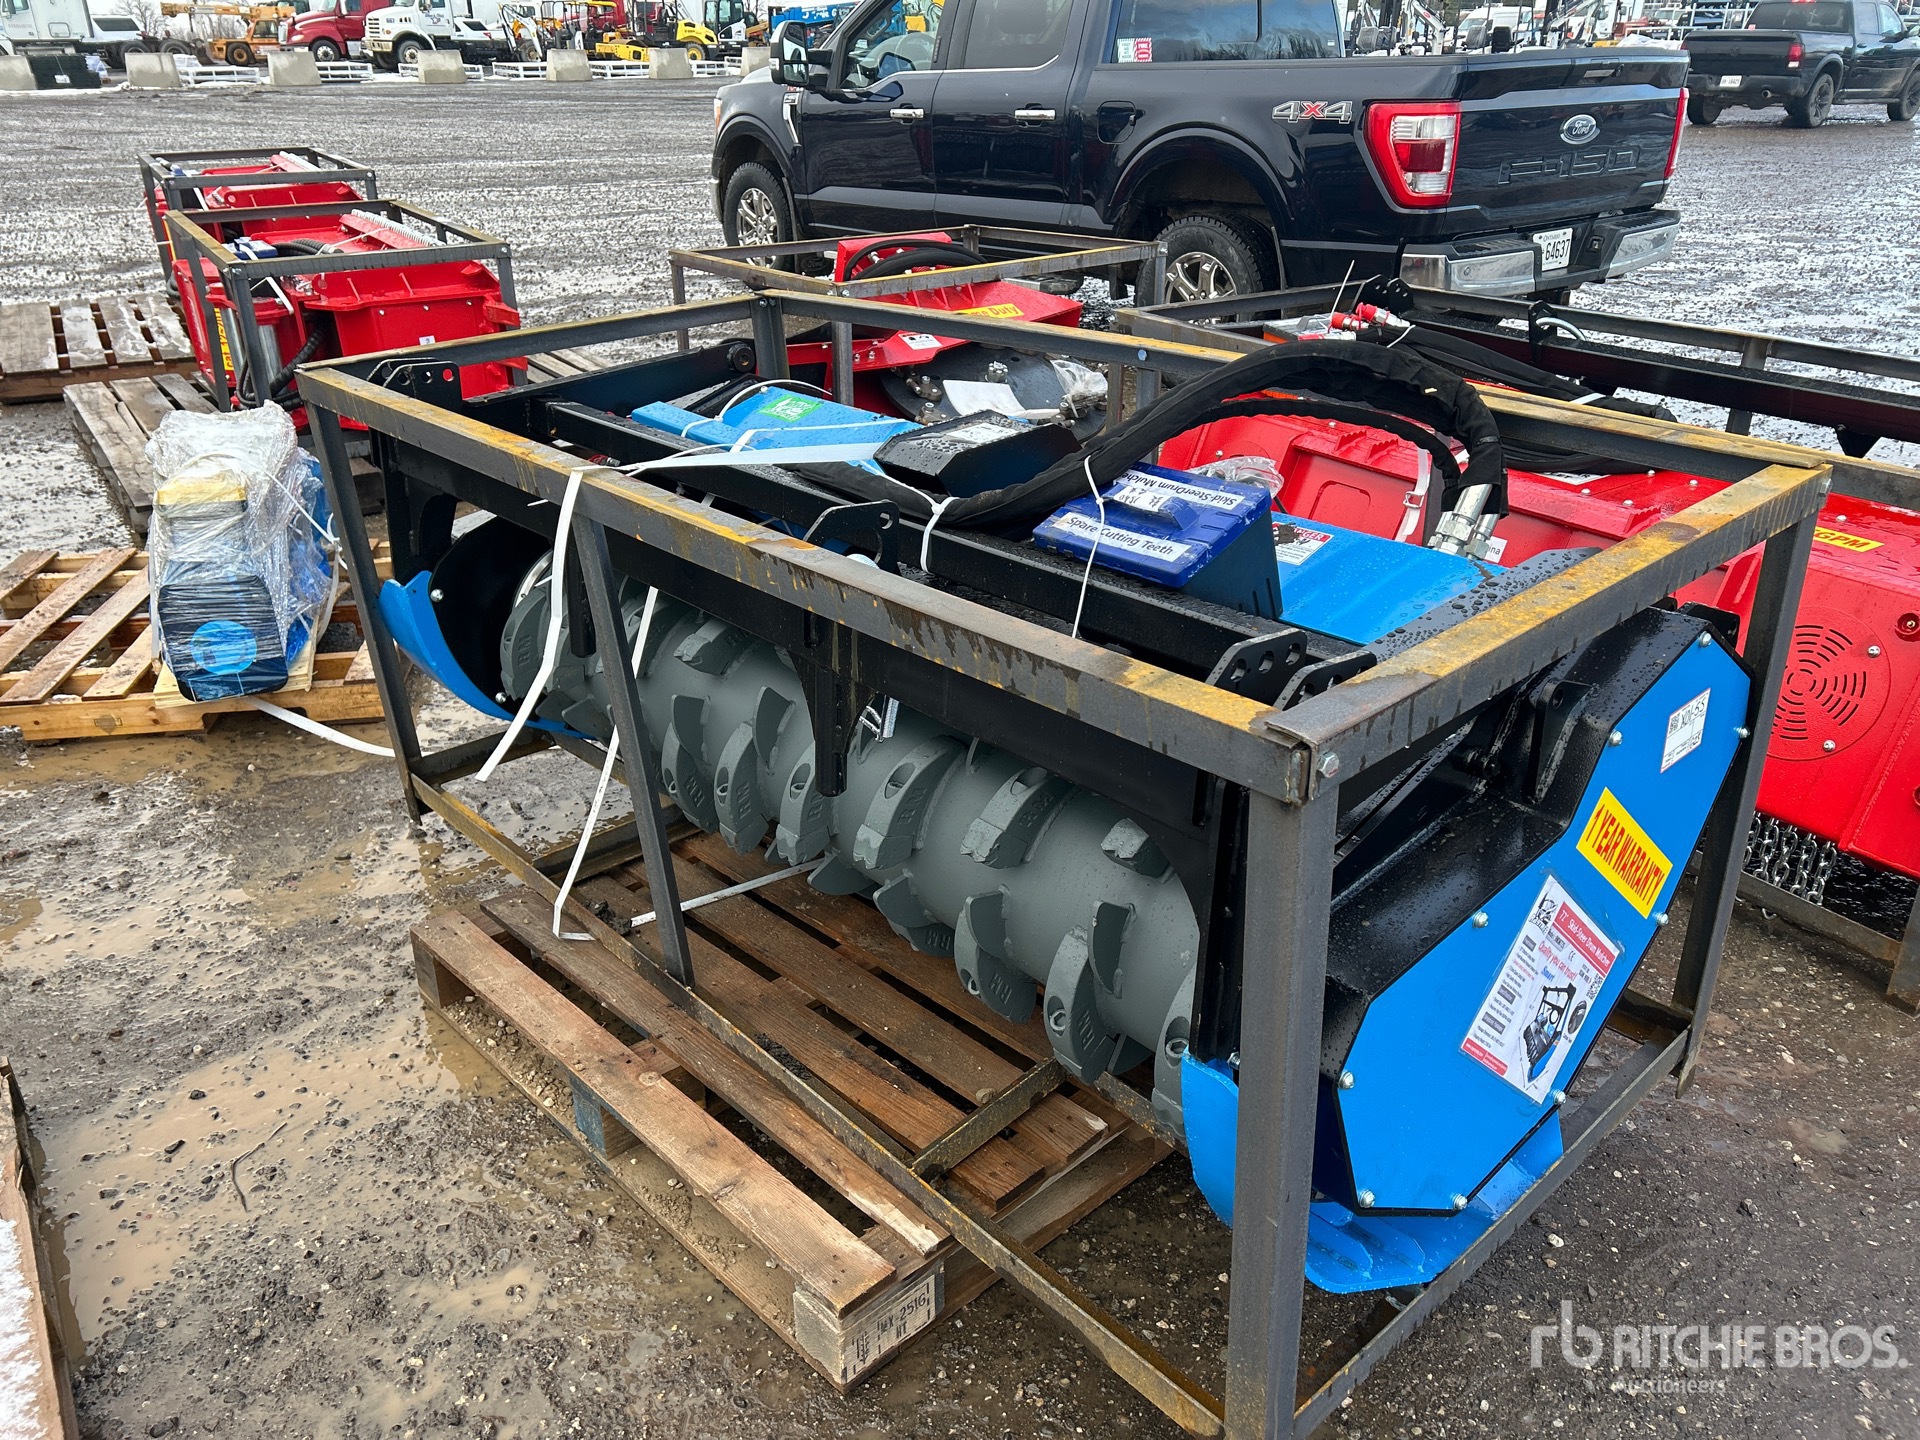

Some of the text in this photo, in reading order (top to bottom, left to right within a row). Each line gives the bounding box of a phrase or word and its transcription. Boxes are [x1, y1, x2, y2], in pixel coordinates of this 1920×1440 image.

[1572, 120, 1592, 135] Ford
[1545, 238, 1571, 261] 64637
[988, 306, 1019, 316] Duty
[1120, 472, 1157, 489] Mulche
[1067, 516, 1174, 556] Spare Cutting Teeth
[1814, 529, 1871, 548] GPM
[1586, 803, 1665, 906] 1 YEAR WARRANTY
[1567, 917, 1588, 945] Skid-Steer
[1584, 936, 1597, 954] Drum
[1594, 946, 1611, 968] Mulcher
[1536, 939, 1554, 962] Quality
[1549, 953, 1561, 969] you
[1558, 961, 1566, 972] can
[1563, 964, 1577, 982] trust!
[1540, 964, 1555, 983] Smart
